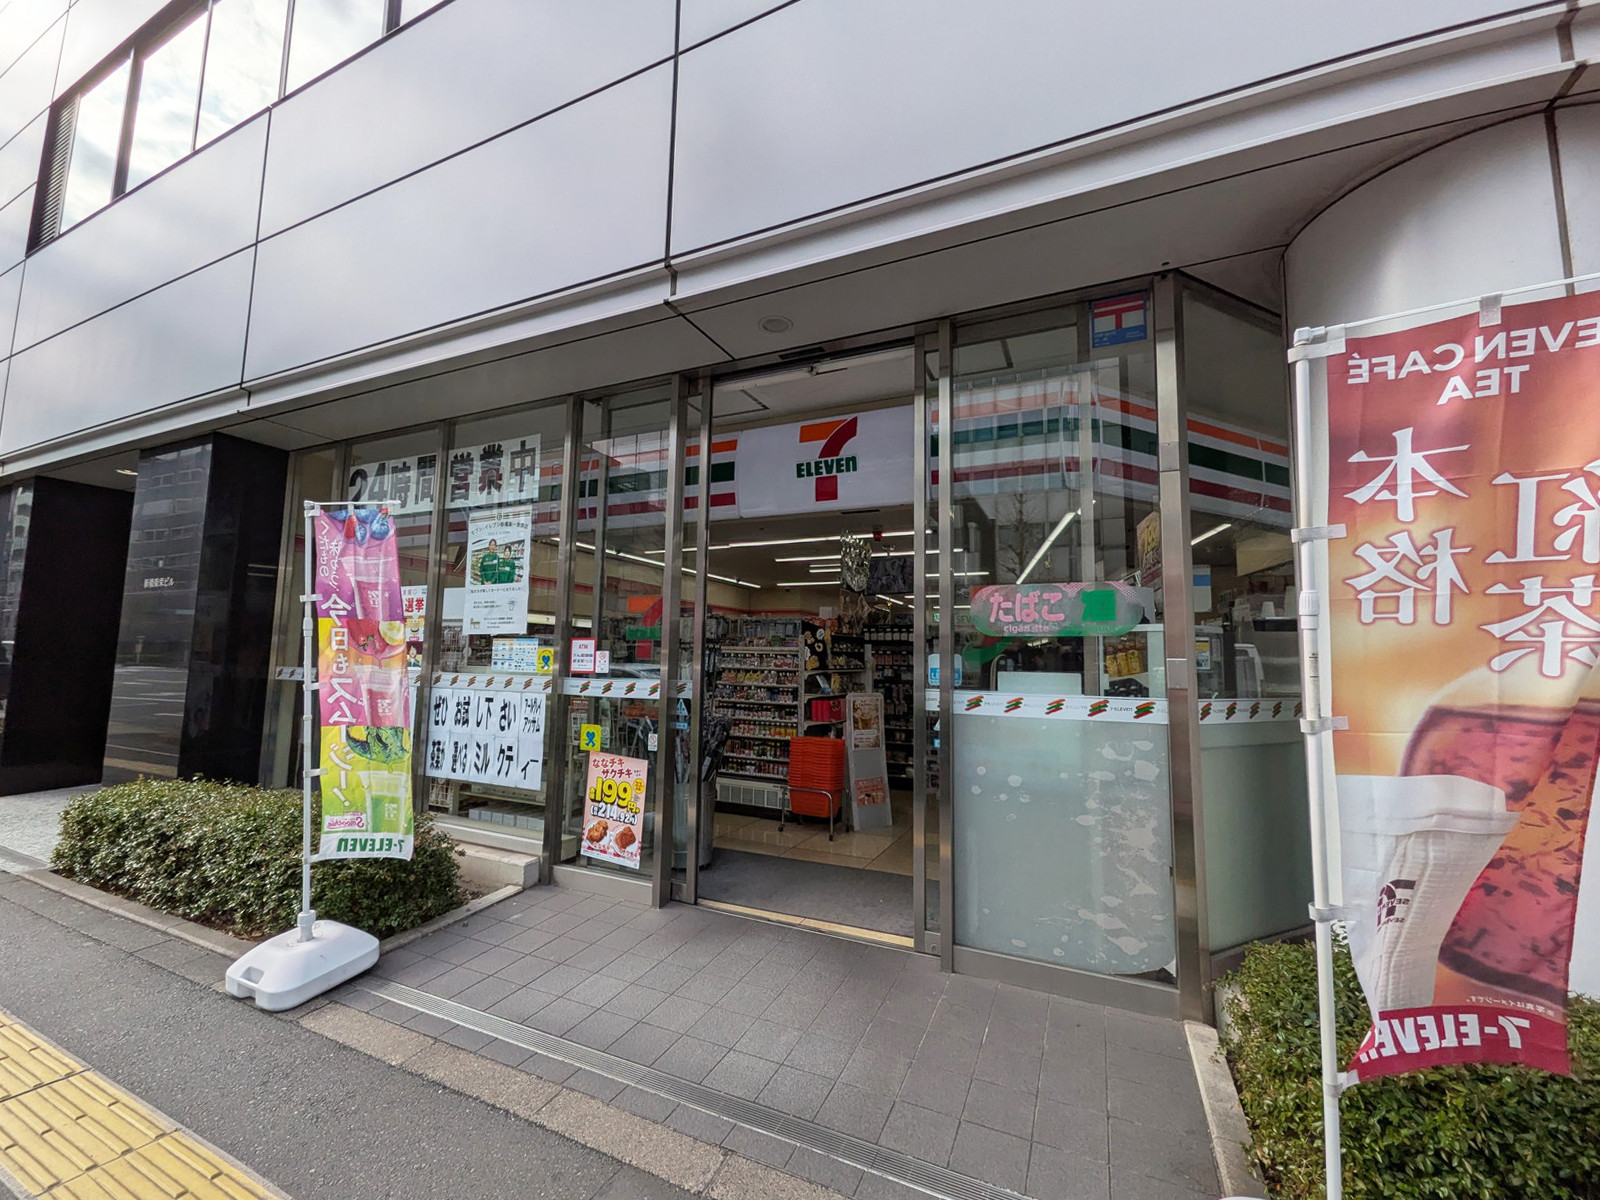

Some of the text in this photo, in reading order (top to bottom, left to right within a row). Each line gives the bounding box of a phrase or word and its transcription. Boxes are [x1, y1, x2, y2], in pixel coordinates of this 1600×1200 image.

[989, 591, 1065, 623] たばこ
[592, 758, 625, 769] ななチキ
[601, 768, 633, 779] ザクチキ
